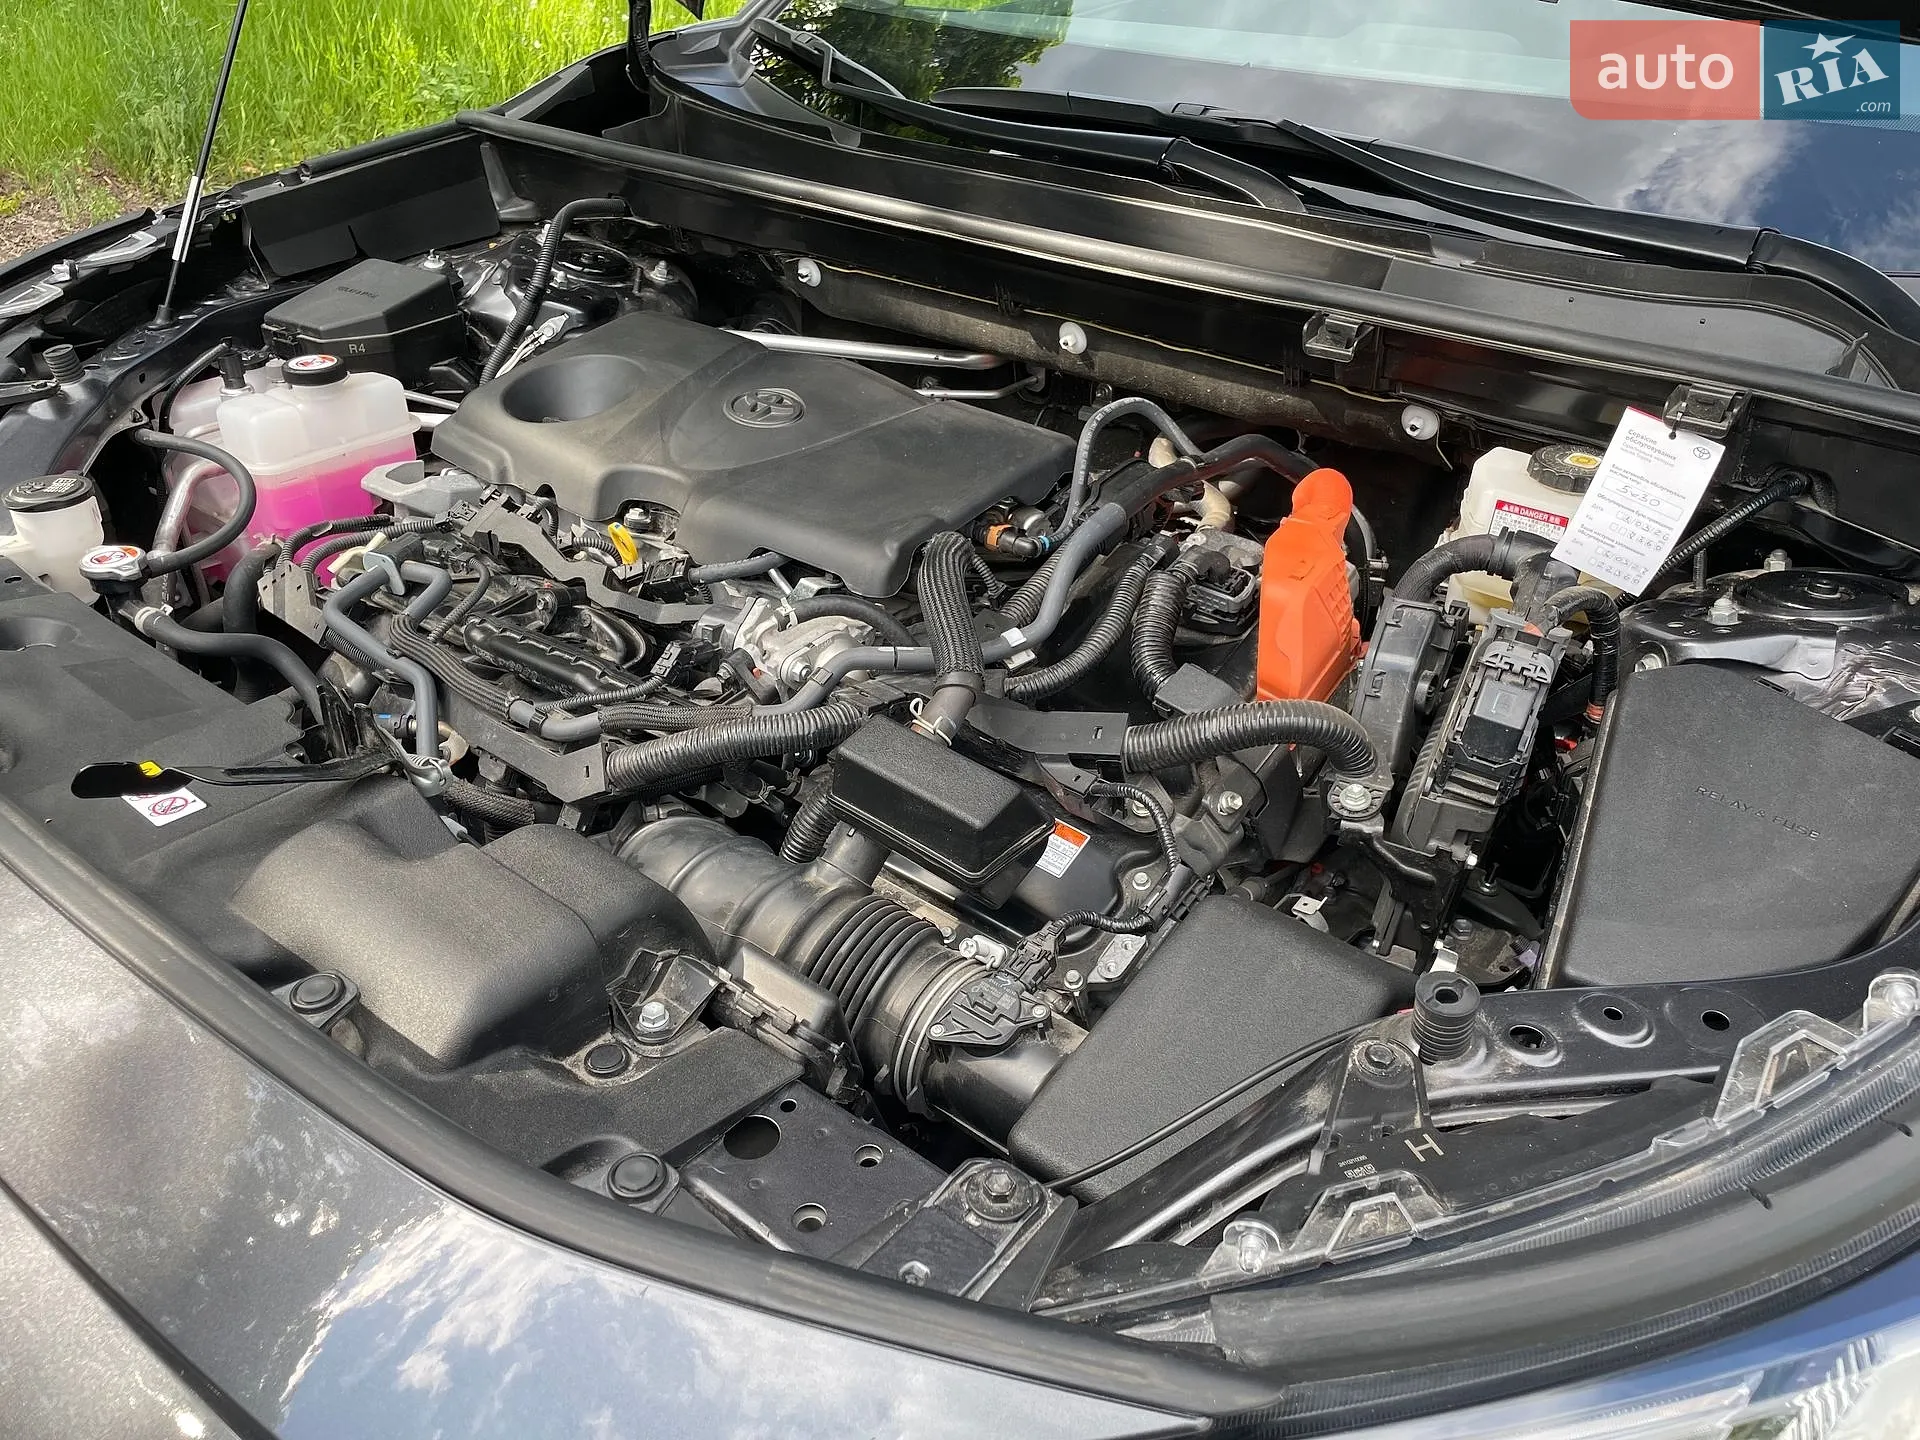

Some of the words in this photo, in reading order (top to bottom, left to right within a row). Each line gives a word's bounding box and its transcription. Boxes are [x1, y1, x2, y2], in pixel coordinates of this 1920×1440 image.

[349, 343, 366, 354] R4
[1519, 509, 1548, 521] DANGER
[1694, 785, 1753, 812] RELAY
[1772, 815, 1820, 840] FUSE
[1404, 1133, 1445, 1163] H
